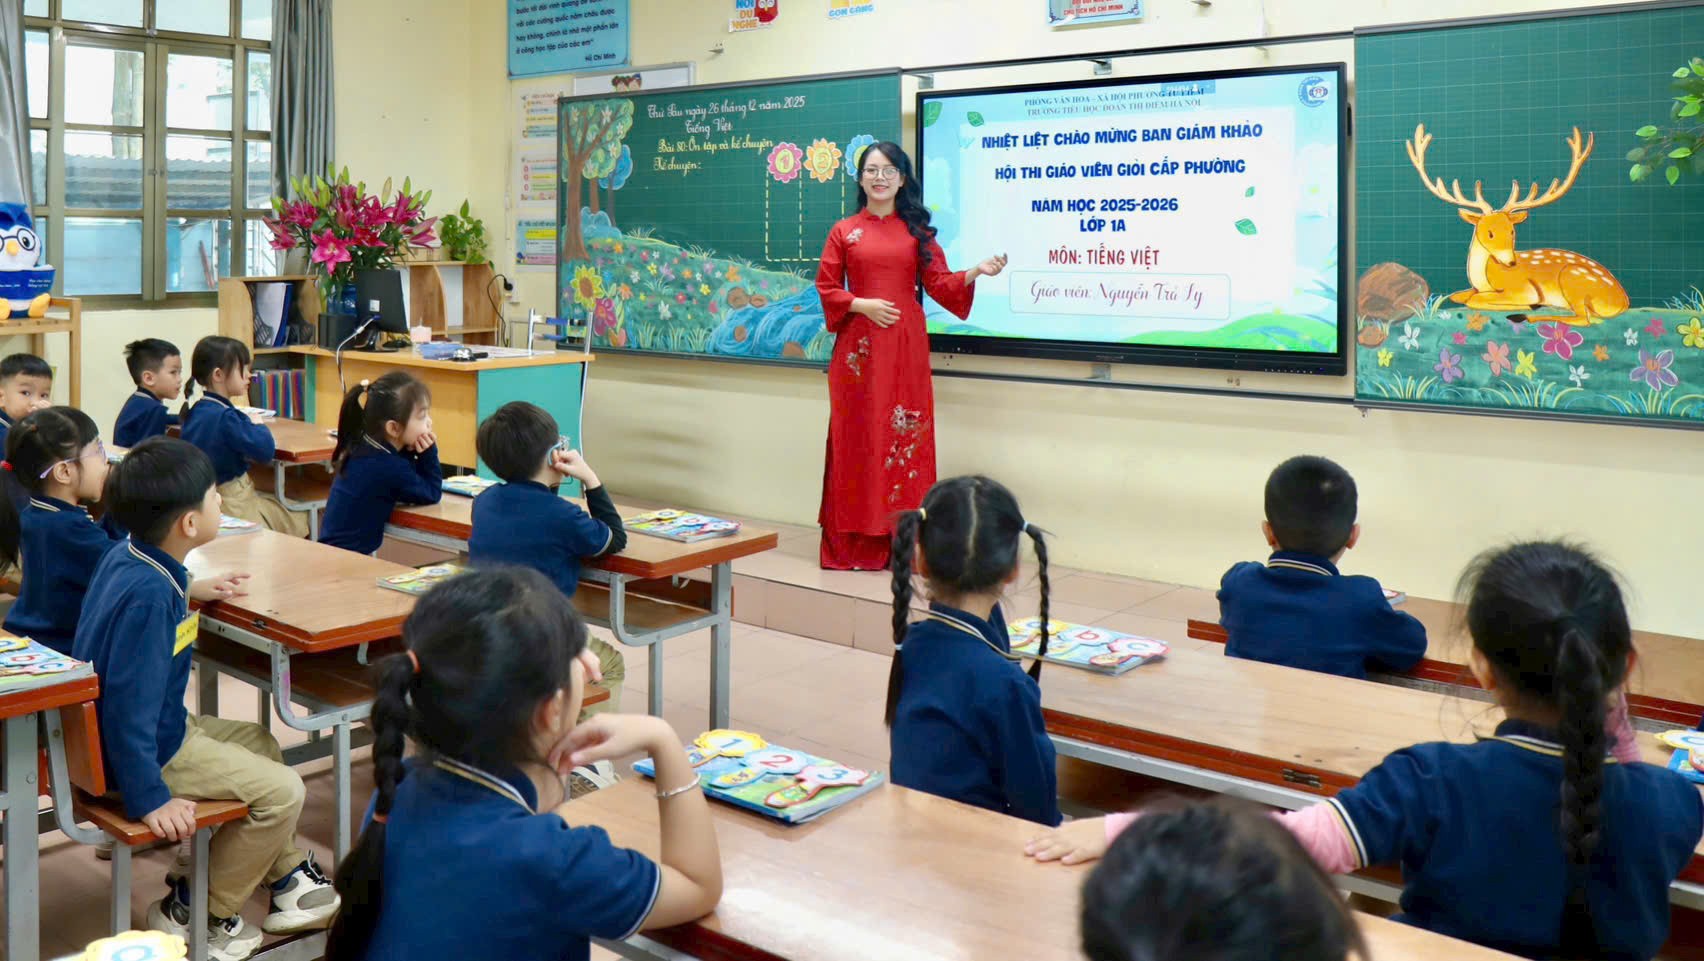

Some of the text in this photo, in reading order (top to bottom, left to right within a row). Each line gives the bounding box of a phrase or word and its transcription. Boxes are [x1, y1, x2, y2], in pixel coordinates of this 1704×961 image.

[685, 106, 707, 121] ngày
[708, 102, 719, 115] 26
[721, 99, 747, 119] tháng
[748, 99, 757, 111] 12
[758, 99, 781, 110] năm
[783, 96, 806, 109] 2025
[685, 117, 733, 140] Tiếng Việt
[982, 132, 1019, 151] NHIỆT
[1023, 131, 1050, 150] LIỆT
[1094, 126, 1137, 144] MỪNG
[1141, 127, 1172, 142] BAN
[1176, 123, 1216, 141] GIÁM
[1221, 120, 1263, 138] KHẢO
[658, 138, 675, 153] Bài
[703, 140, 717, 155] tập
[719, 139, 729, 150] và
[742, 134, 774, 156] chuyện
[781, 154, 790, 170] 1
[817, 153, 829, 169] 2
[995, 155, 1246, 182] HỘI THI GIÁO VIÊN GIỎI CẤP PHƯỜNG
[1031, 197, 1179, 216] NĂM HỌC 2025-2026
[1079, 215, 1126, 232] LỚP 1A
[1048, 242, 1160, 270] MÔN: TIẾNG VIỆT
[1030, 280, 1060, 304] Giáo
[1099, 282, 1149, 308] Nguyễn
[721, 738, 742, 750] 1
[760, 754, 793, 768] 2
[817, 769, 848, 782] 3
